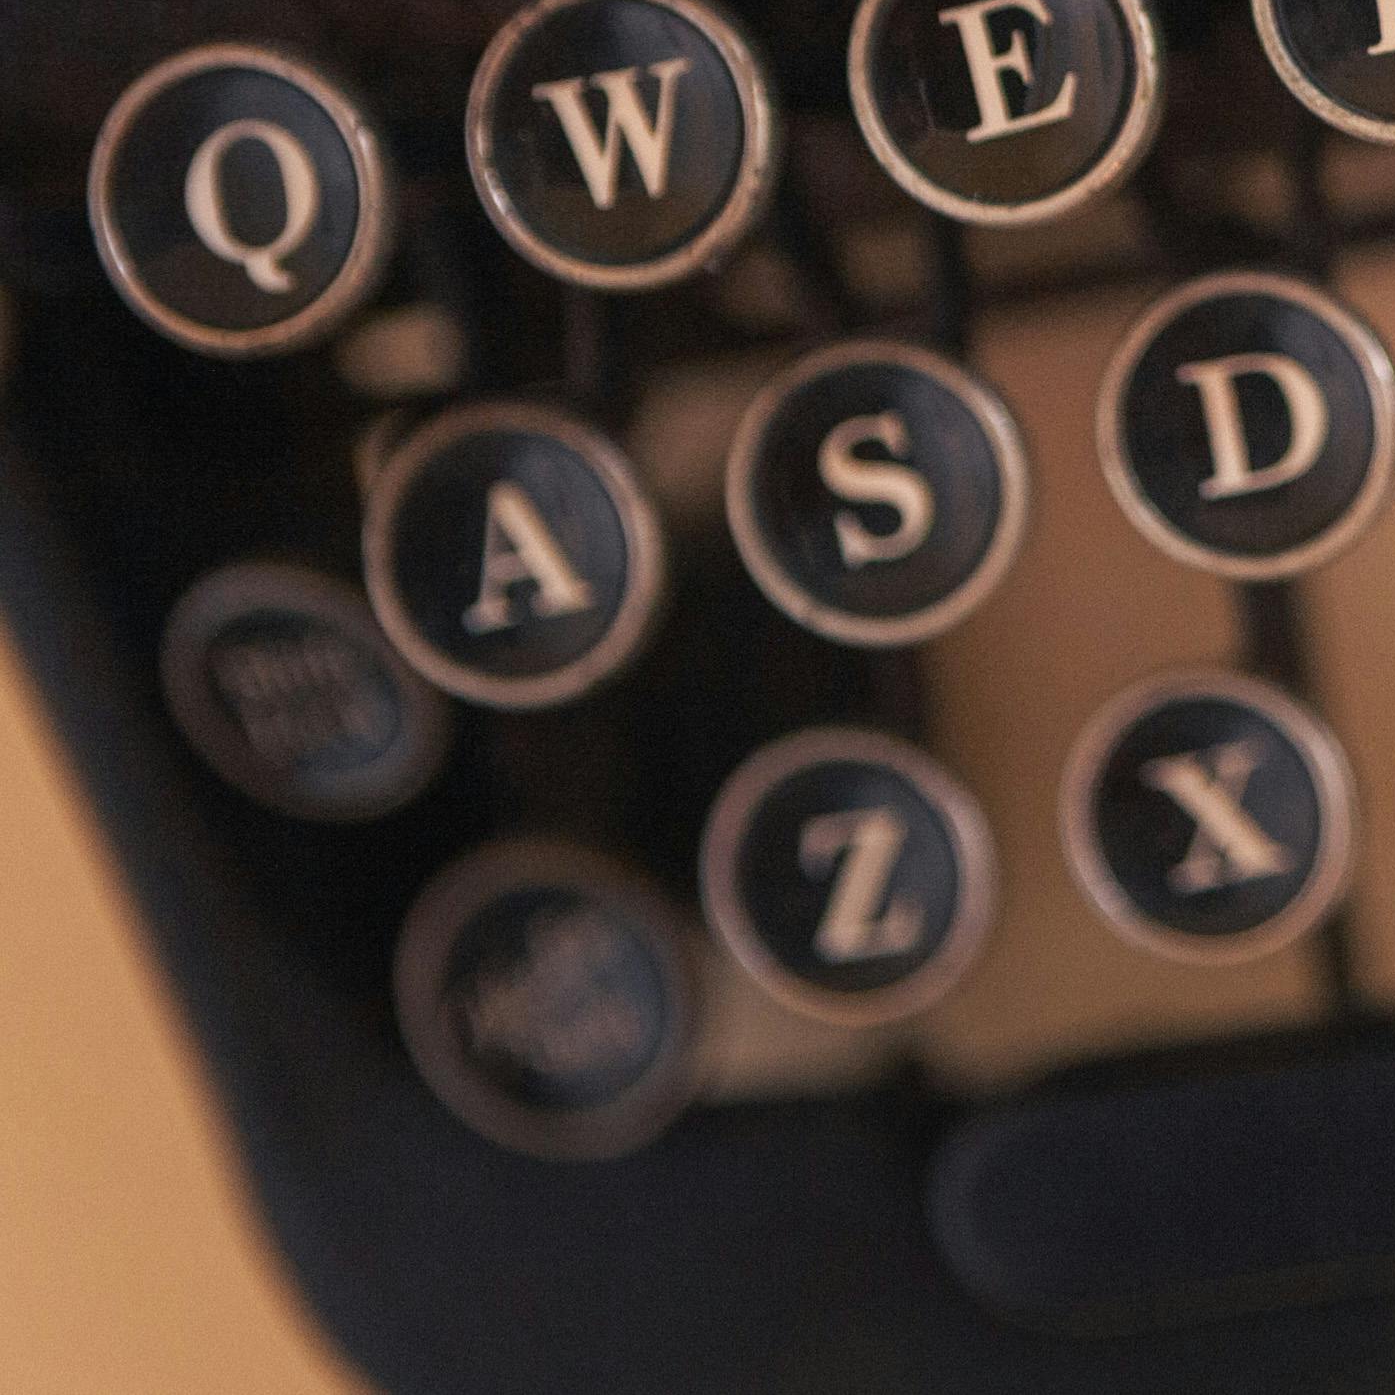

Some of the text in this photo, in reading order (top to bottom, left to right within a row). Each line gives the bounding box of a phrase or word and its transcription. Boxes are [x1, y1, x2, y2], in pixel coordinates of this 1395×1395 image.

[186, 121, 318, 291] Q
[536, 53, 688, 209] W
[818, 413, 934, 567] S
[1180, 353, 1332, 498] D
[462, 483, 590, 630] A
[803, 805, 922, 961] Z
[1152, 737, 1285, 888] X
